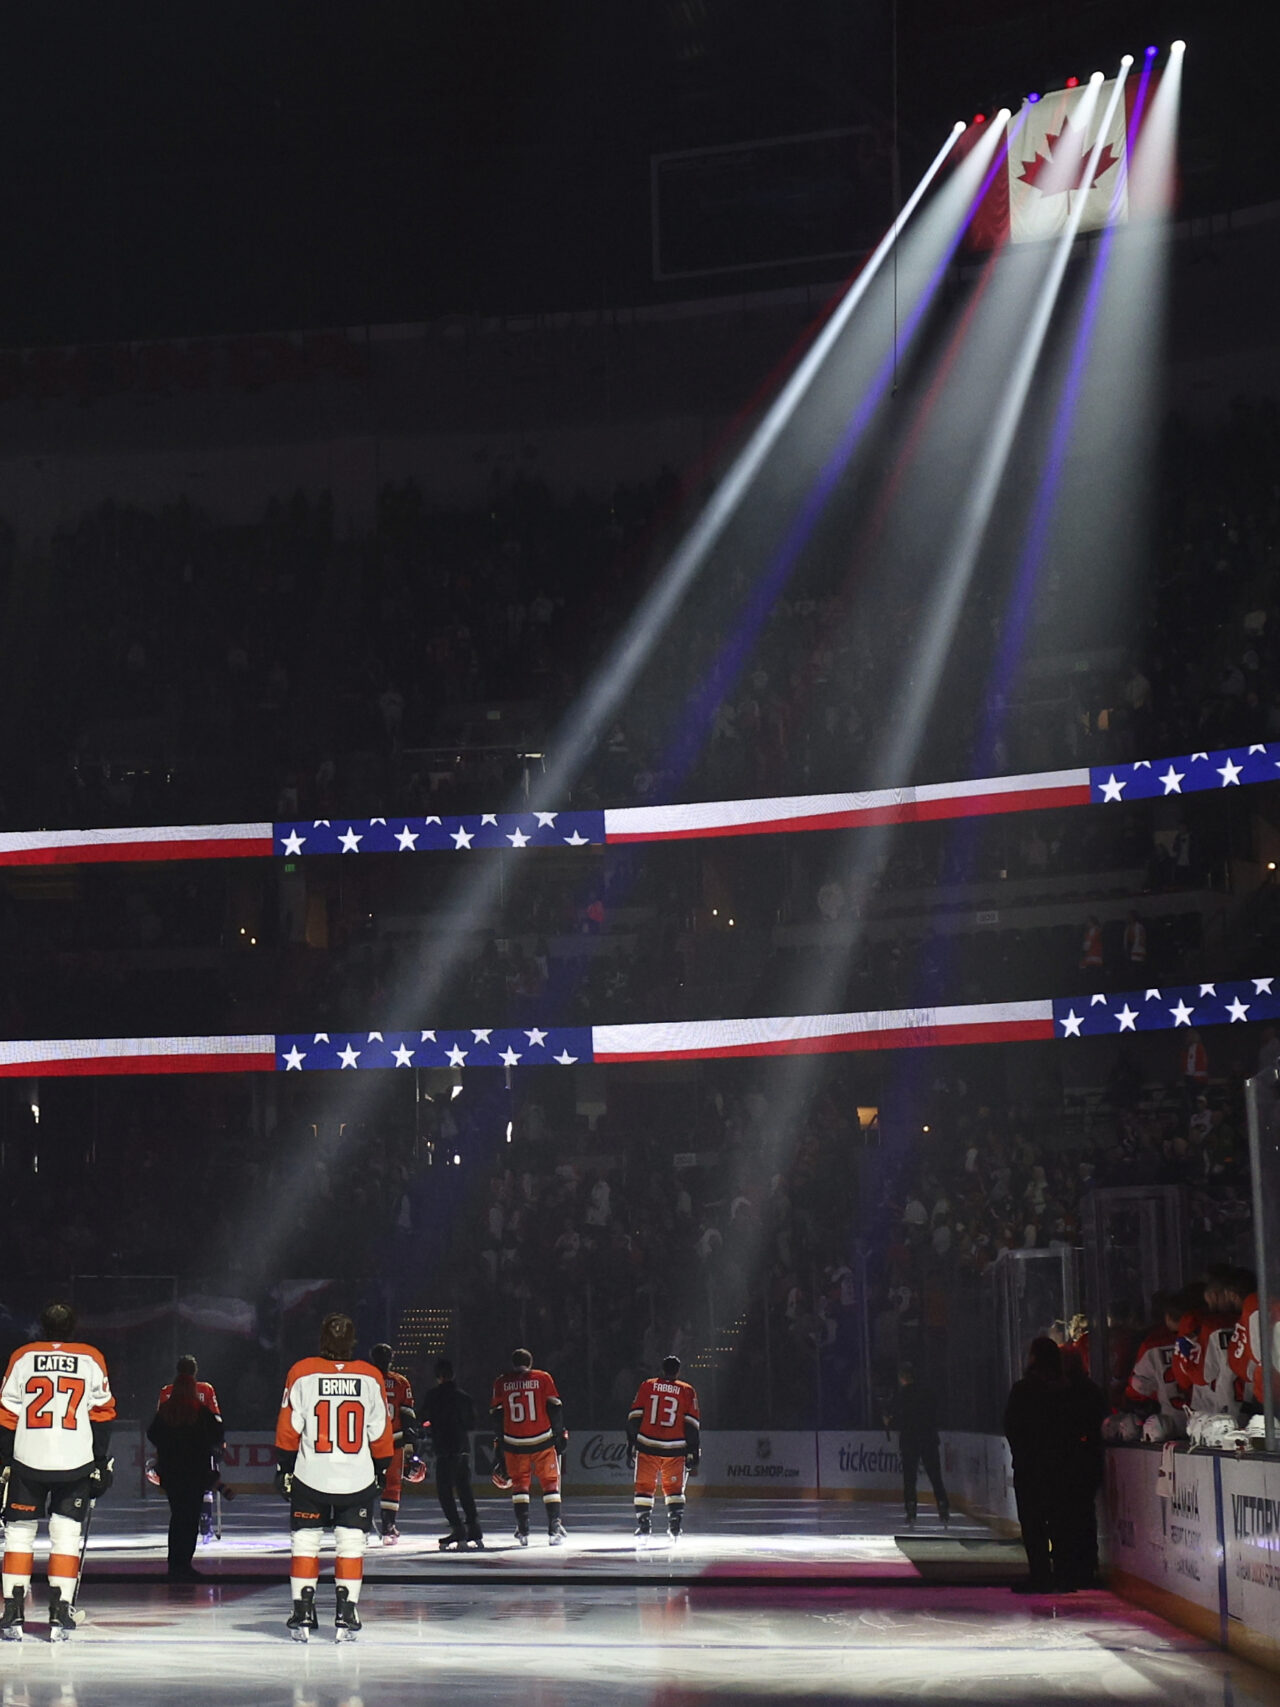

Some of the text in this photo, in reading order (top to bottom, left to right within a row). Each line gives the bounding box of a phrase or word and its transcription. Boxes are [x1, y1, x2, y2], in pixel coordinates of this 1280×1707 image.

[37, 1356, 76, 1372] CATES
[322, 1379, 358, 1396] BRINK
[503, 1379, 540, 1392] GAUTHIER
[652, 1382, 681, 1396] FABBRI
[25, 1376, 86, 1431] 27
[508, 1390, 537, 1423] 61
[649, 1394, 679, 1428] 13
[314, 1400, 365, 1454] 10
[839, 1443, 905, 1474] ticketm
[293, 1511, 321, 1520] CCM
